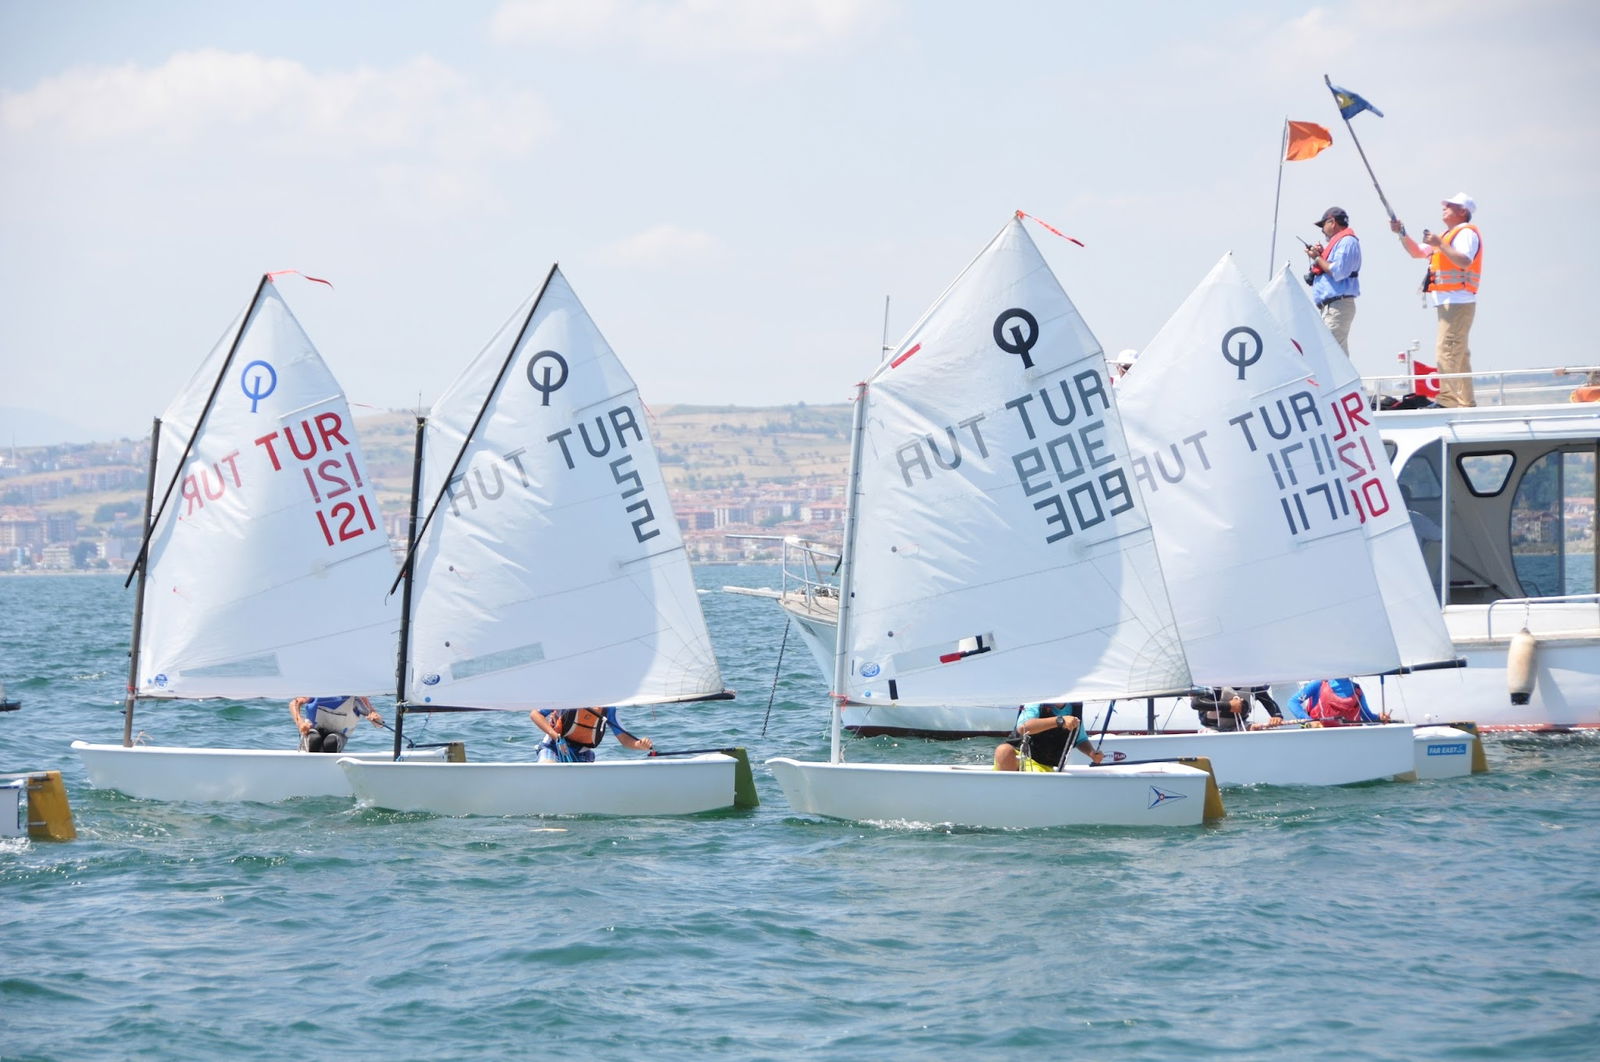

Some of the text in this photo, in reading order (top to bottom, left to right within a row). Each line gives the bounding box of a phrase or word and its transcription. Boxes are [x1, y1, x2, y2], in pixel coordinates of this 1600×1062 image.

[1005, 369, 1110, 440] TUR
[1229, 391, 1323, 452] TUR
[254, 412, 350, 471] TUR
[546, 405, 643, 470] TUR
[316, 494, 376, 546] 121
[1033, 467, 1135, 544] 309
[1280, 478, 1349, 535] 1171
